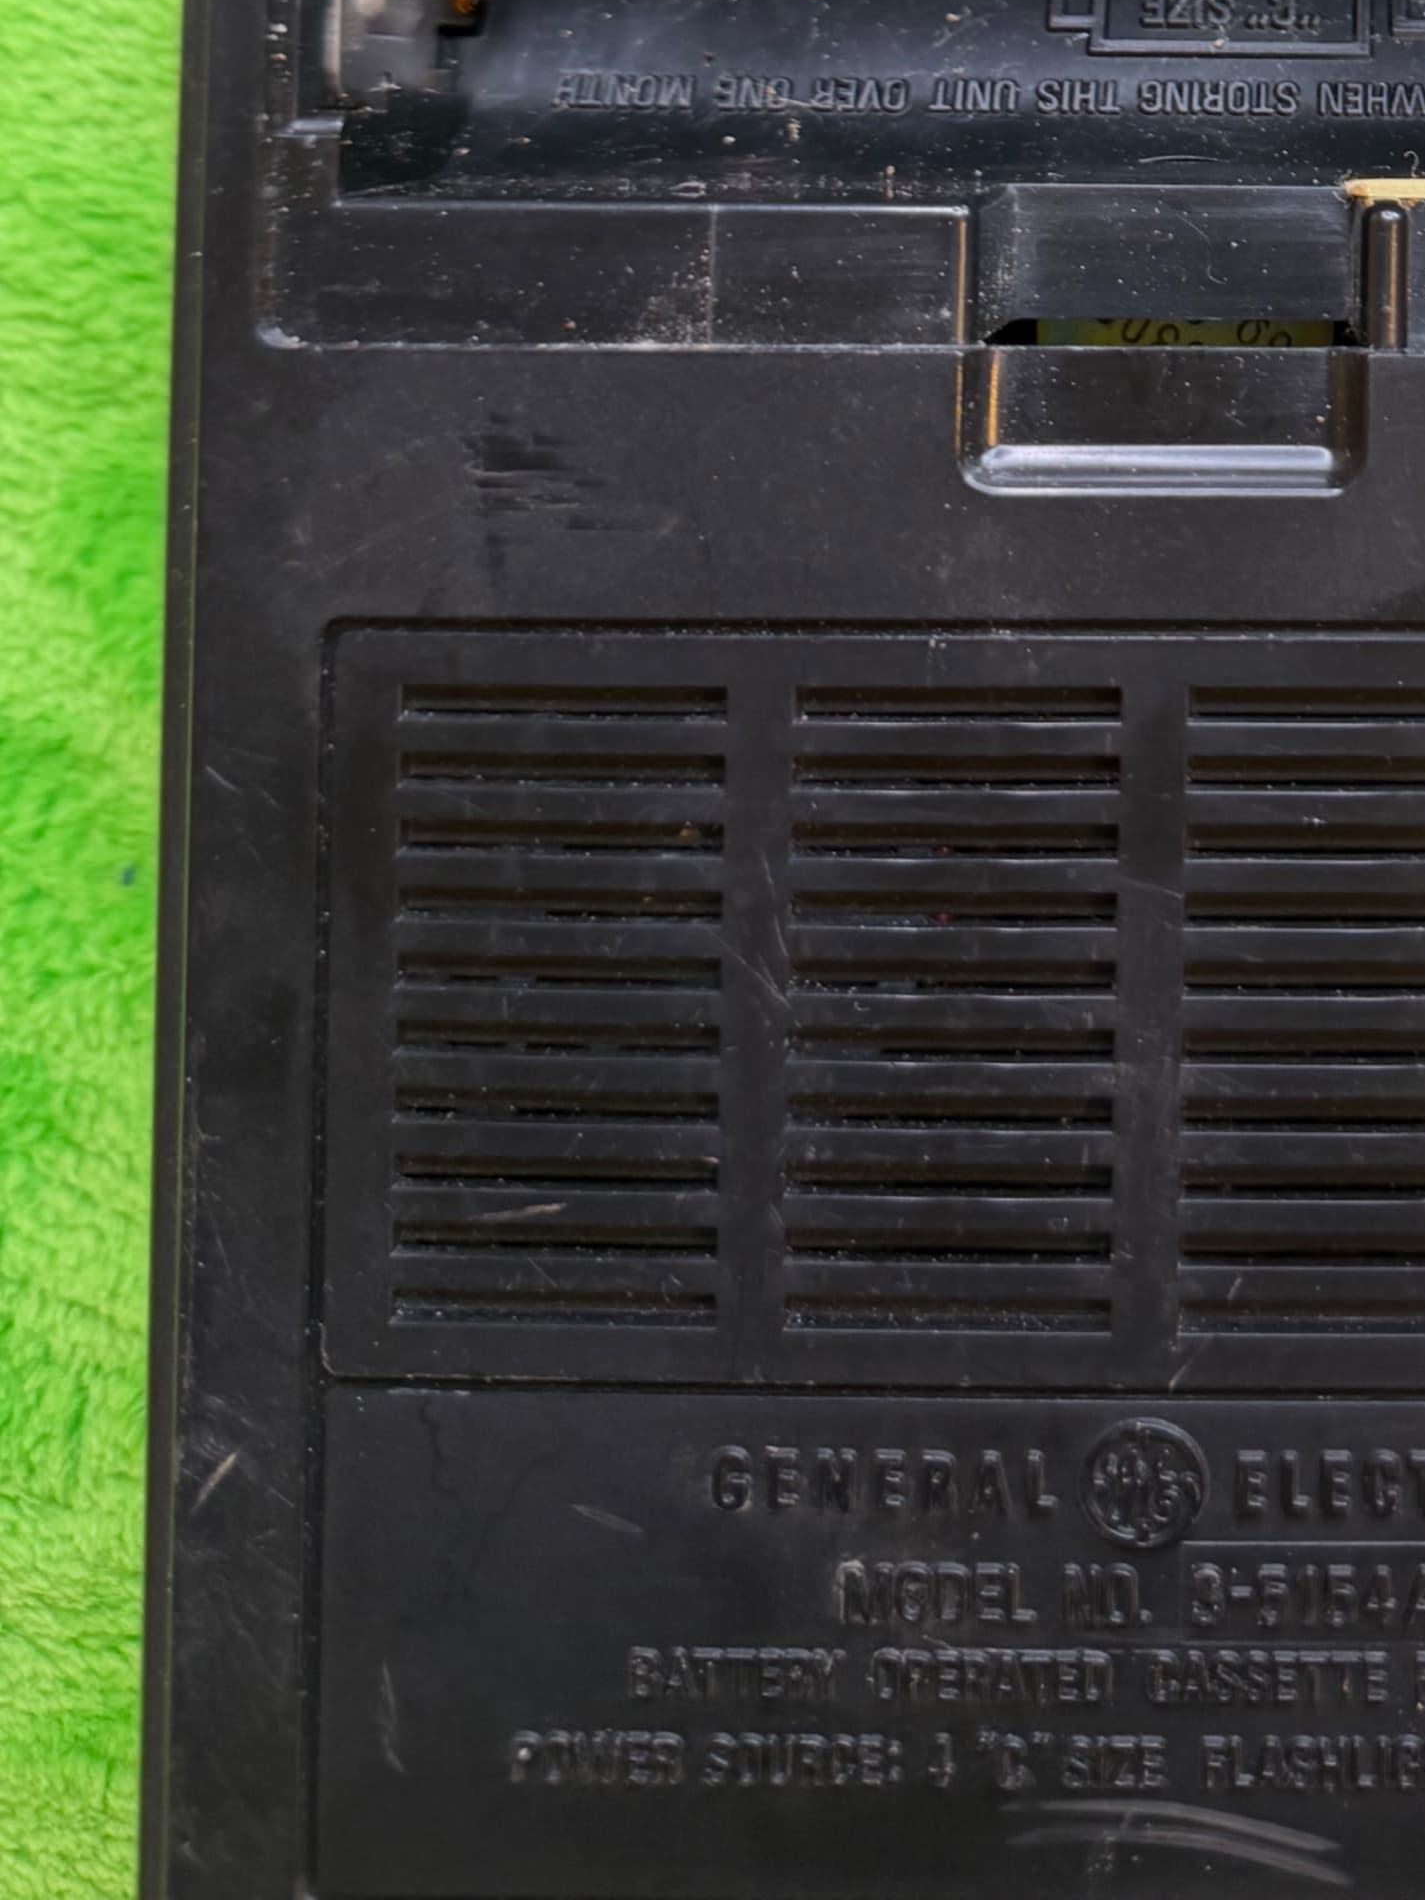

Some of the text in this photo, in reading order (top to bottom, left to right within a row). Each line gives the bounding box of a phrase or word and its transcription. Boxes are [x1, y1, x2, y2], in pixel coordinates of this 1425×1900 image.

[552, 75, 696, 111] MONTH
[714, 76, 794, 112] ONE
[807, 77, 907, 113] OVER
[928, 78, 1020, 114] UNIT
[1036, 79, 1119, 116] THIS
[1140, 79, 1301, 119] STORING
[710, 1444, 1059, 1513] GENERAL
[837, 1560, 1040, 1627] MODEL
[1061, 1561, 1153, 1627] NO.
[625, 1645, 847, 1701] BATTERY
[868, 1646, 1116, 1702] OPERATED
[1147, 1647, 1391, 1704] CASSETTE
[509, 1728, 686, 1788] POWER
[702, 1729, 906, 1789] SOURCE:
[1058, 1731, 1171, 1790] SIZE
